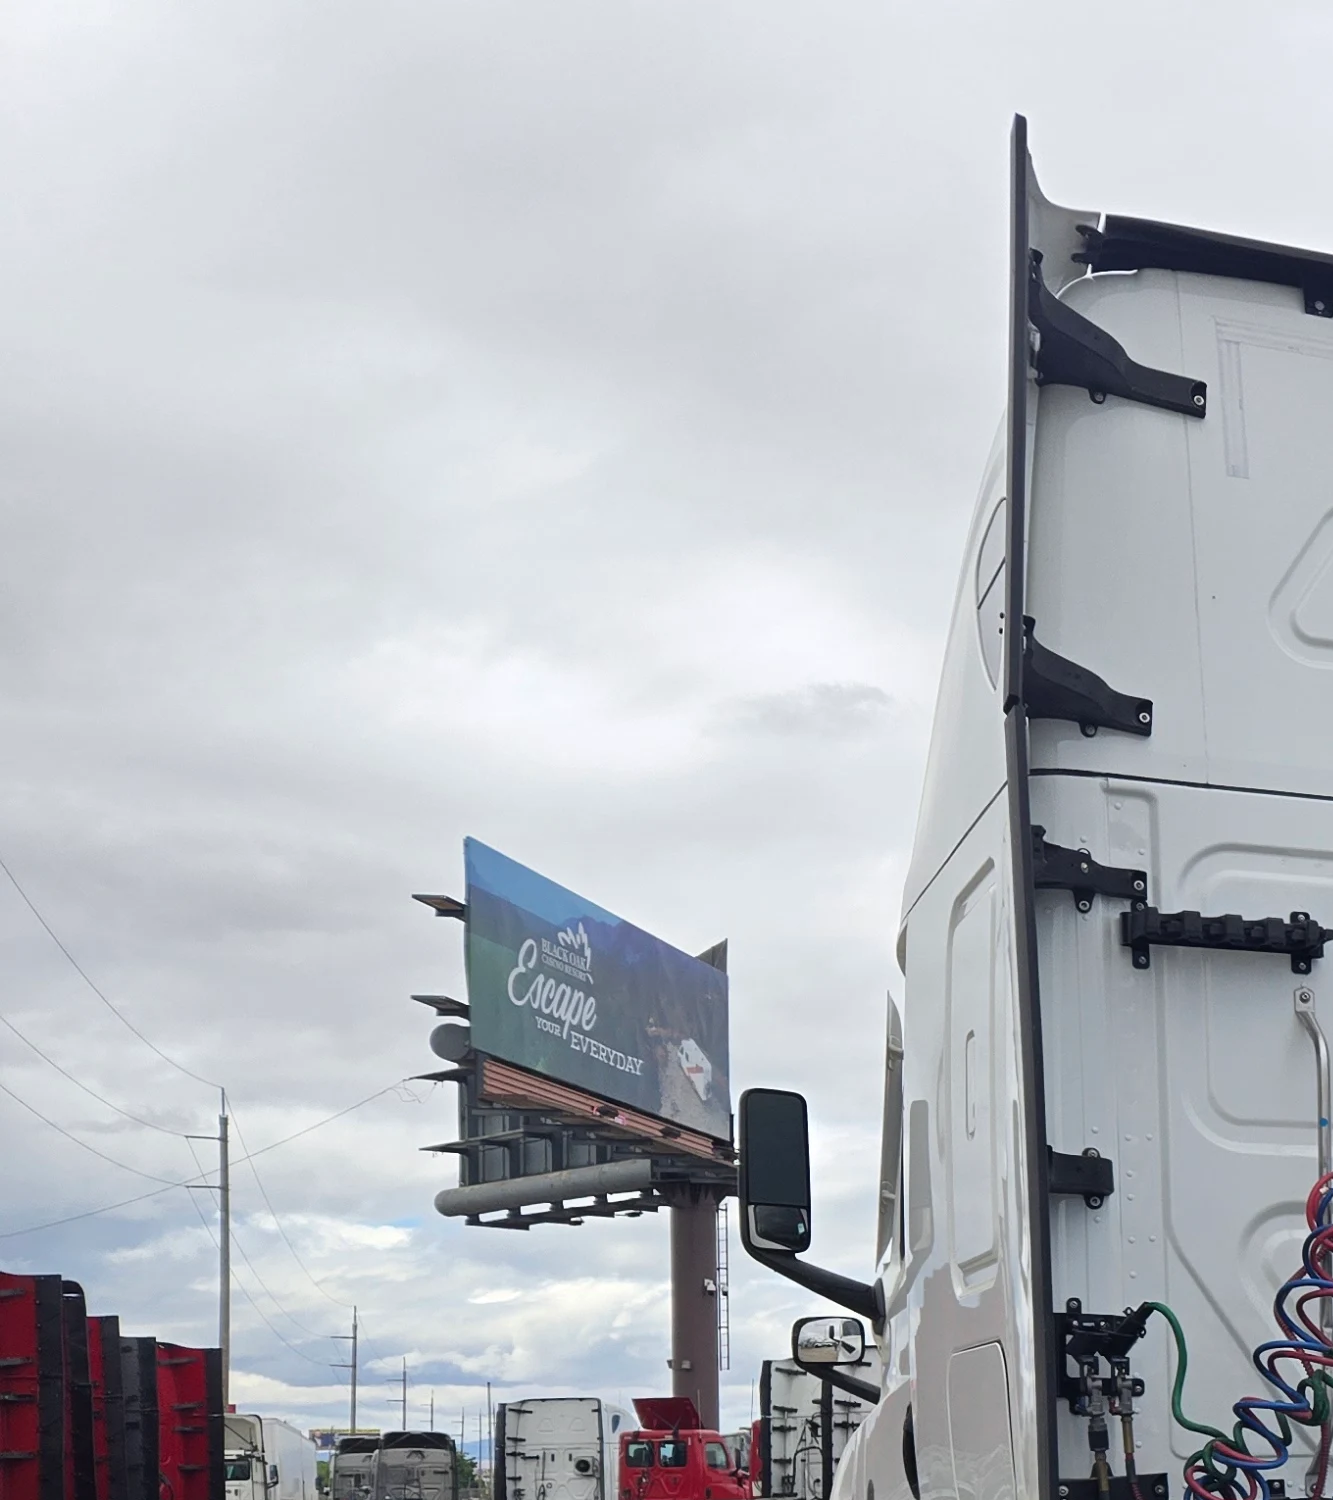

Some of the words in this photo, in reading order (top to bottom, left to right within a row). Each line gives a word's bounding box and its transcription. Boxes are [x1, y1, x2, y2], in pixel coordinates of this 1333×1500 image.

[541, 937, 569, 963] BLACK
[508, 938, 597, 1040] Escape
[535, 1016, 561, 1037] YOUR
[570, 1031, 645, 1076] EVERYDAY
